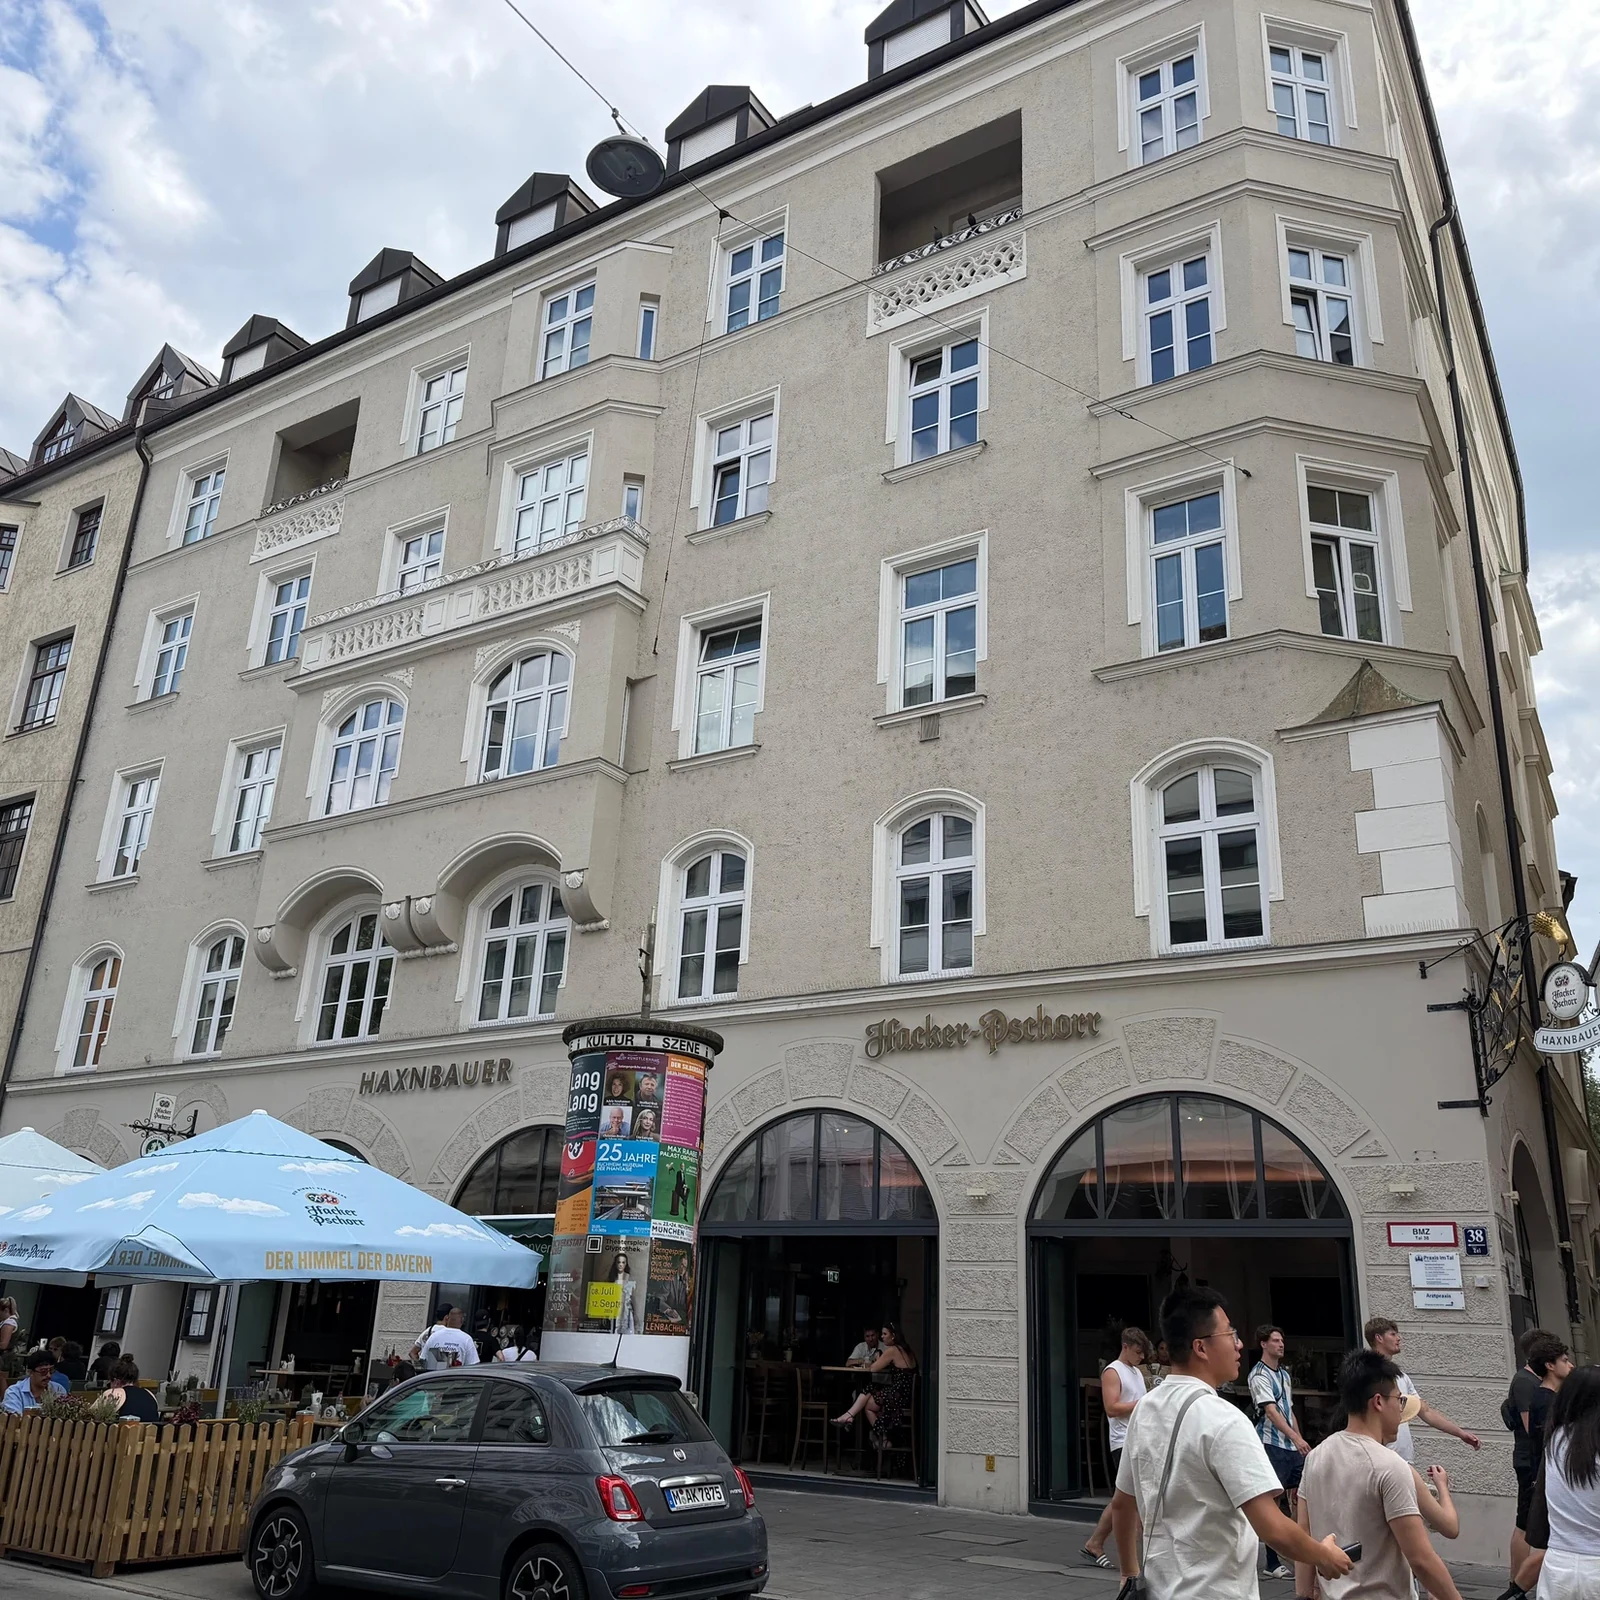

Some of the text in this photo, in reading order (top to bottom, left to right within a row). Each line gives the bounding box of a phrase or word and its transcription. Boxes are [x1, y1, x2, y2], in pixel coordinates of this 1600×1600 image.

[1552, 988, 1576, 1001] Hacker
[1552, 998, 1578, 1011] Pschorr
[864, 1004, 1103, 1060] Hacker-Pschorr
[586, 1034, 634, 1048] KULTUR
[662, 1037, 700, 1055] SZENE
[359, 1058, 514, 1095] HAXNBAUER
[570, 1071, 601, 1091] Lang
[568, 1093, 599, 1113] Lang
[598, 1143, 622, 1162] 25
[622, 1153, 657, 1164] JAHRE
[660, 1150, 680, 1159] PALAST
[667, 1145, 682, 1154] MAX
[304, 1205, 358, 1217] Hacker
[309, 1215, 366, 1227] Pschorr
[652, 1225, 687, 1236] MÜNCHEN
[1412, 1228, 1431, 1236] BMZ
[1467, 1229, 1484, 1243] 38
[605, 1245, 641, 1253] Glyptothek
[265, 1251, 432, 1273] DER HIMMEL DER BAYERN
[601, 1286, 614, 1295] Juli
[671, 1490, 682, 1506] M
[685, 1488, 700, 1504] AK
[698, 1485, 723, 1502] 7875
